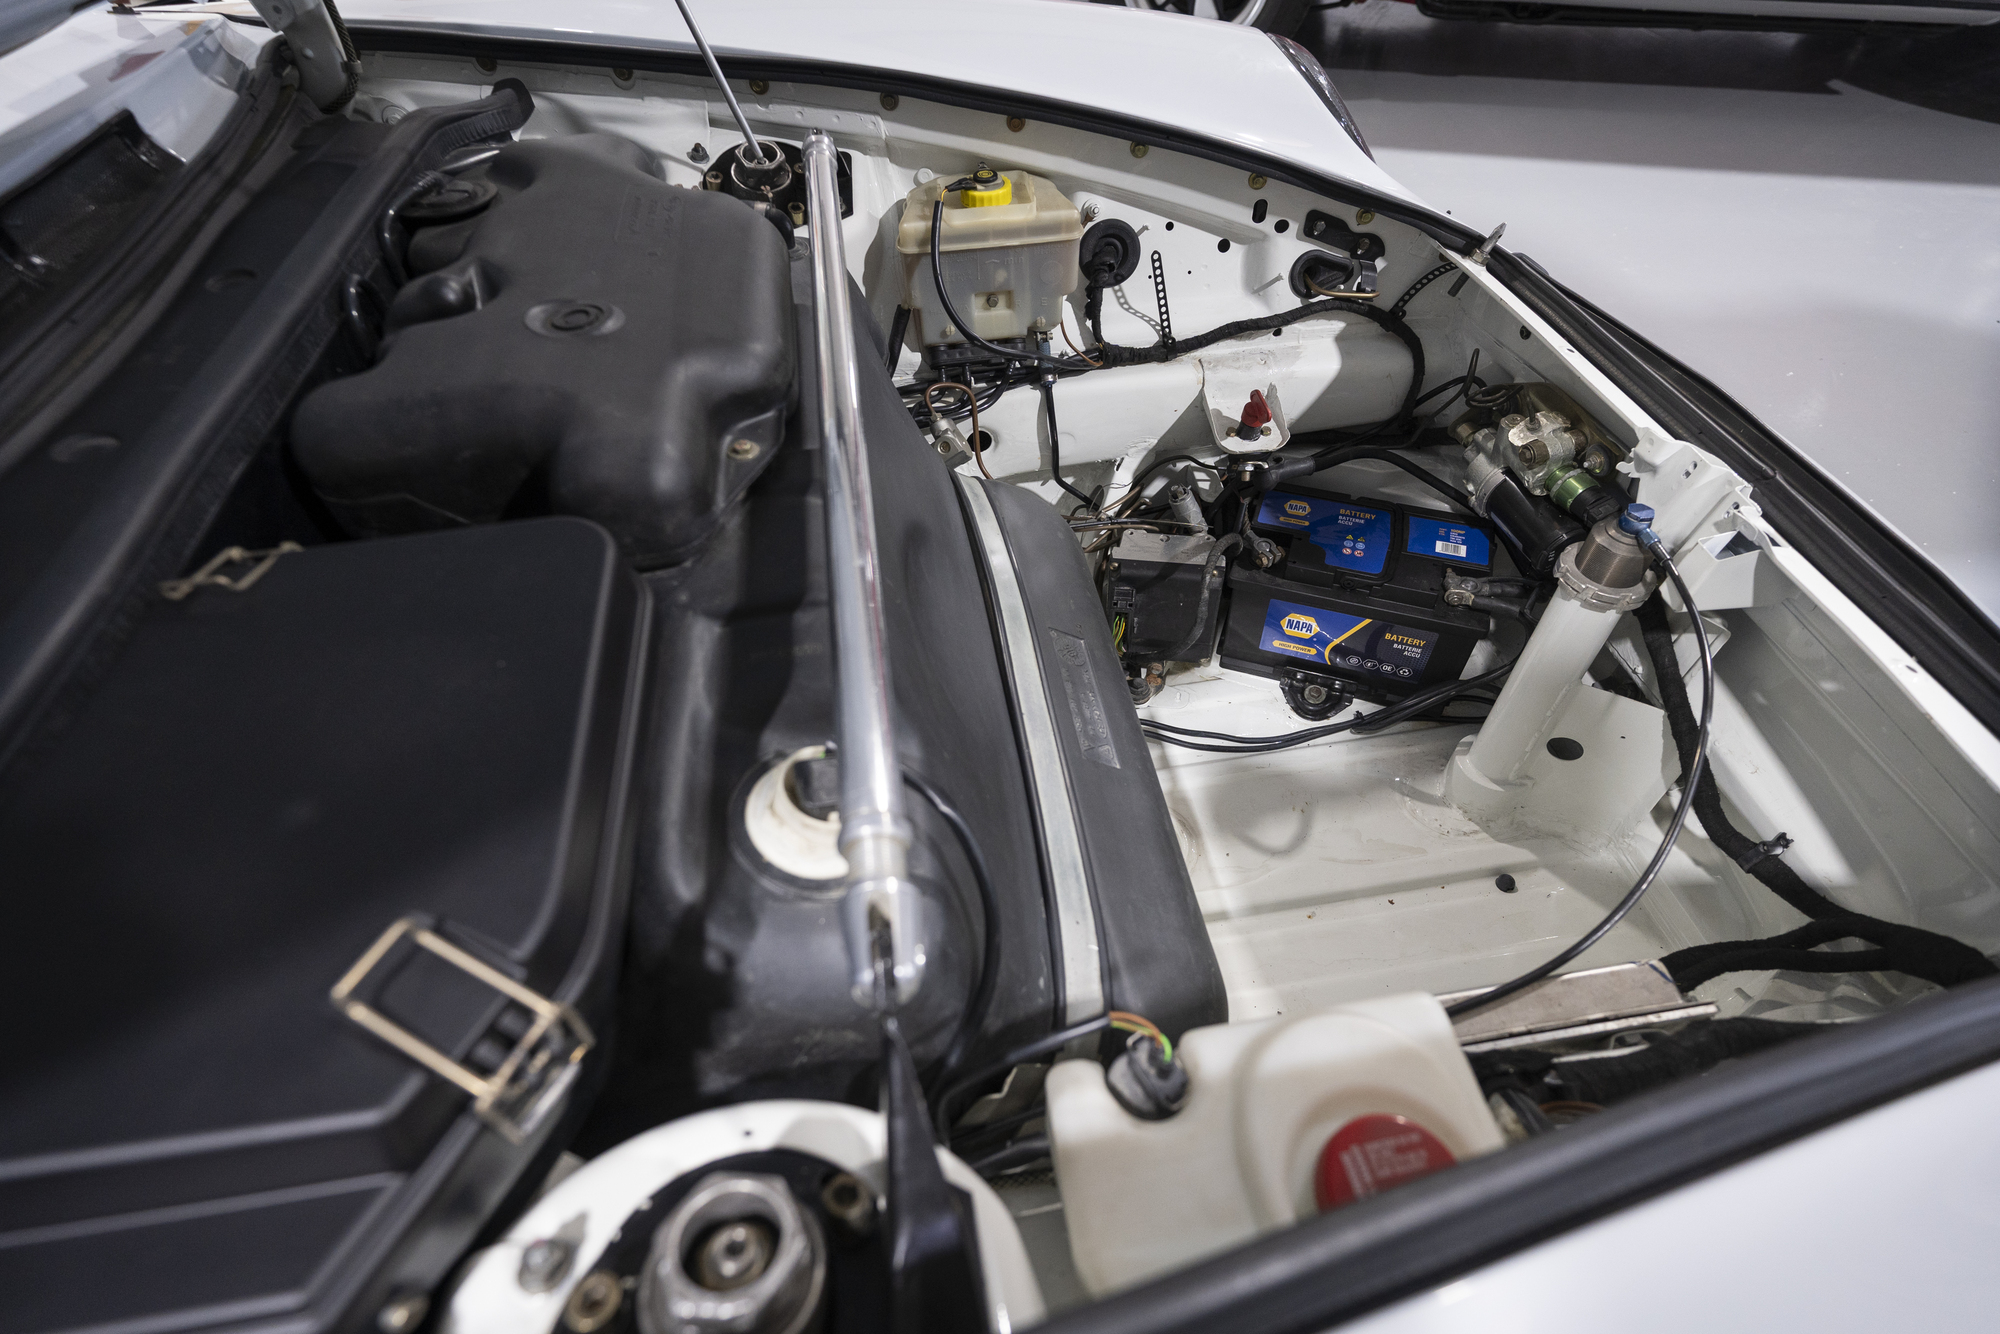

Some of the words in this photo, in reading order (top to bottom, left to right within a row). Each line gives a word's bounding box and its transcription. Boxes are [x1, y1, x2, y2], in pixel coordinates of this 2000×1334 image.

[1287, 503, 1307, 513] NAPA
[1338, 515, 1365, 524] BATTERIE
[1340, 508, 1376, 520] BATTERY
[1285, 618, 1313, 634] NAPA
[1384, 632, 1427, 647] BATTERY
[1292, 645, 1312, 653] POWER
[1393, 643, 1423, 654] BATTERIE
